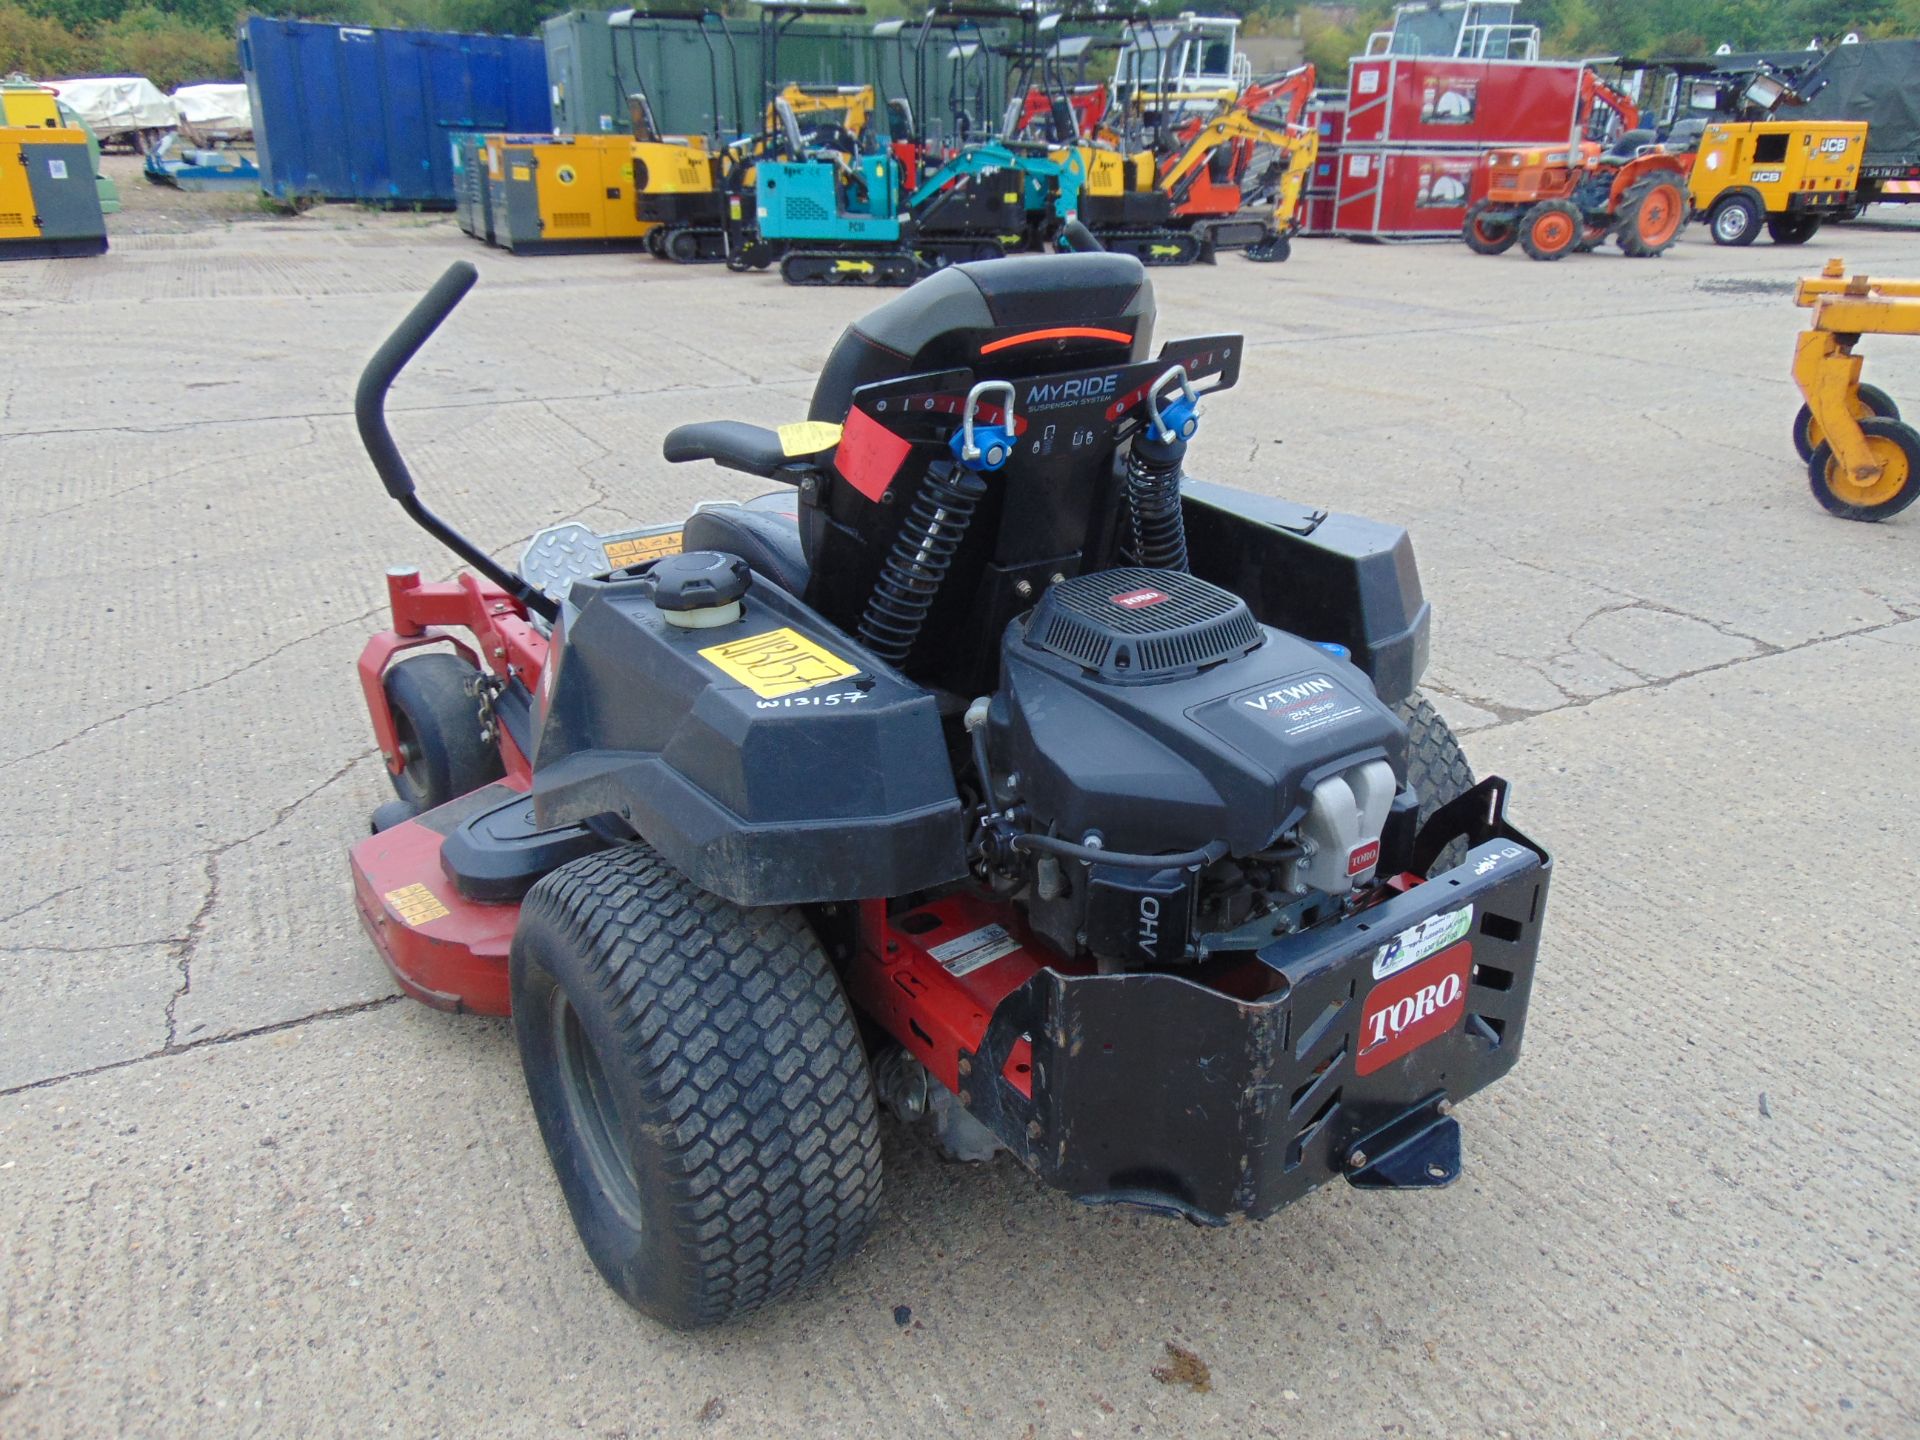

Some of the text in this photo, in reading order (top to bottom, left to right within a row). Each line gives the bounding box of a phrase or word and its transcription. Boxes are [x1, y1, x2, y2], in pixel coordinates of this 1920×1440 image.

[1821, 139, 1847, 152] JCB
[1751, 172, 1781, 182] JCB
[1026, 374, 1118, 405] MYRIDE
[1028, 395, 1111, 413] SUSPENSION SYSTEM
[1120, 592, 1159, 605] TORO
[1352, 850, 1377, 867] TORO
[1139, 896, 1160, 958] OHV
[1368, 973, 1463, 1046] TORO
